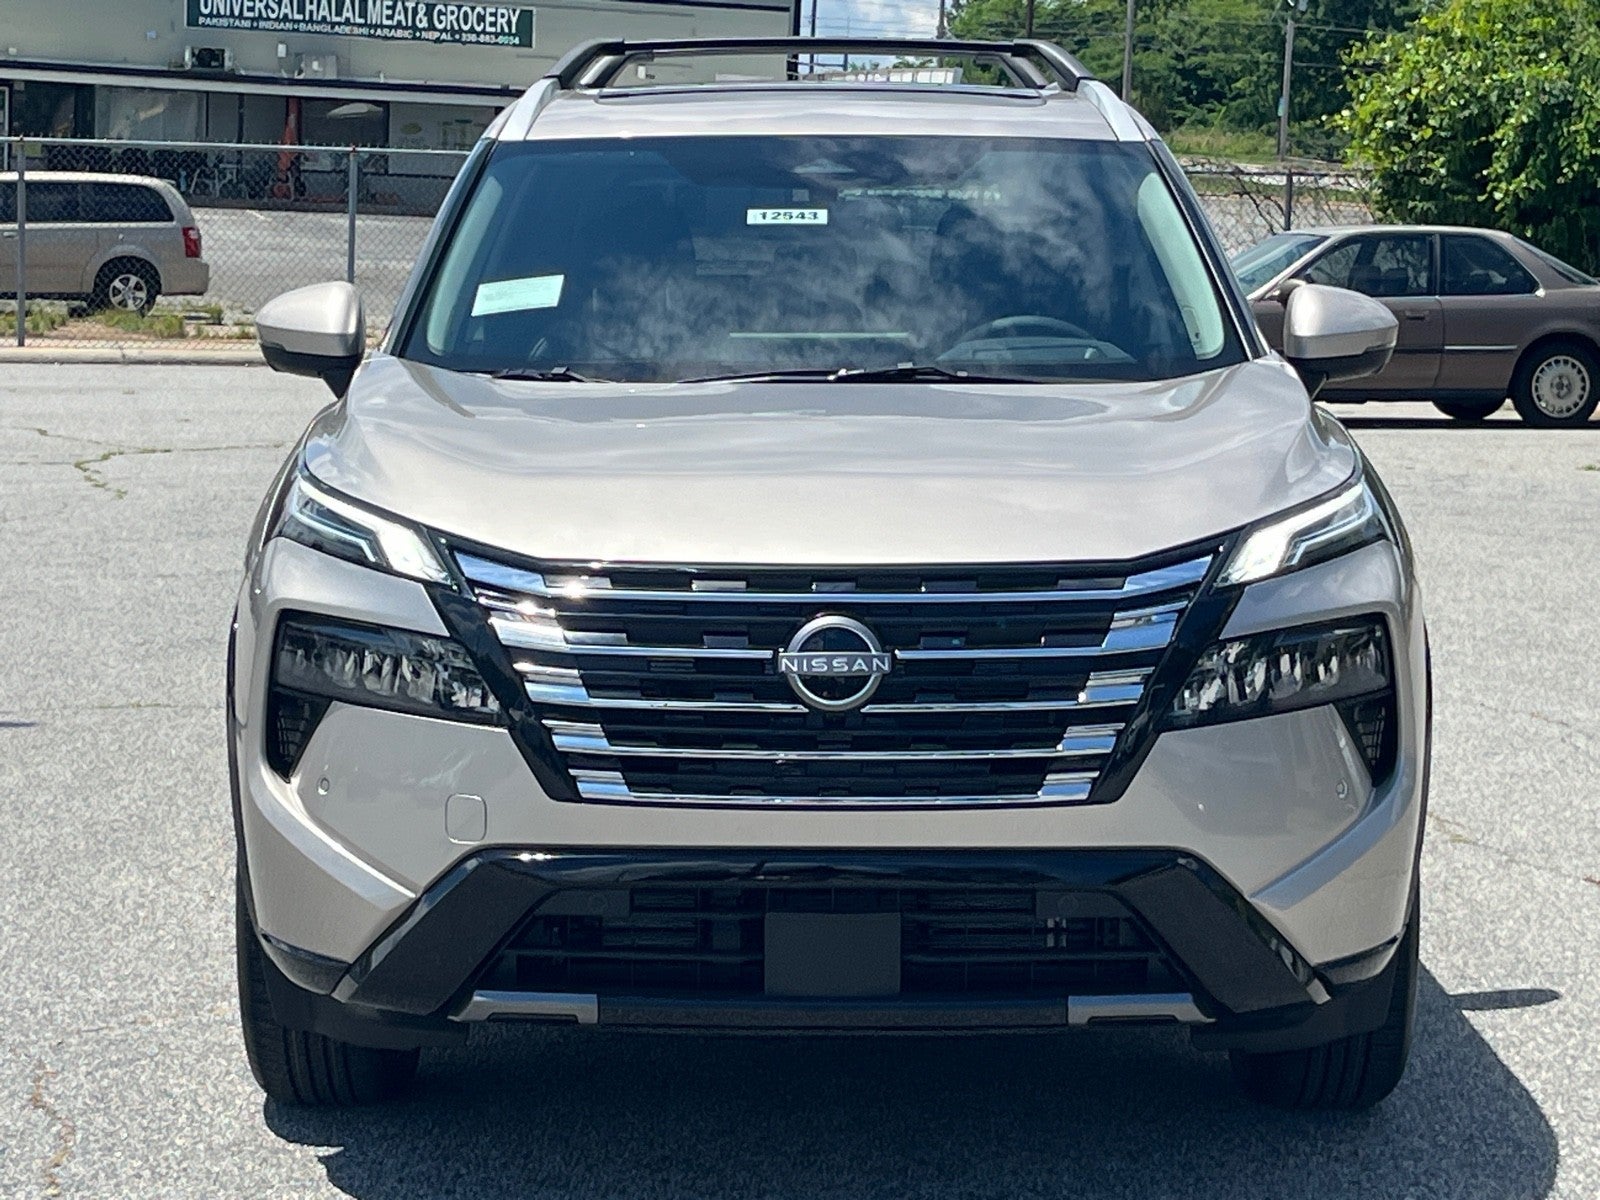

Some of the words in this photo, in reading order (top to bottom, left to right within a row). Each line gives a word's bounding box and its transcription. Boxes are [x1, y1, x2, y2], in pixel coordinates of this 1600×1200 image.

[200, 0, 303, 20] UNIVERSAL
[305, 0, 367, 24] HALAL
[367, 0, 415, 27] MEAT
[415, 3, 428, 28] &
[433, 4, 520, 34] GROCERY
[258, 21, 293, 31] INDIAN
[375, 27, 414, 39] ARABIC
[420, 31, 454, 41] NEPAL
[760, 211, 819, 220] 12543
[781, 657, 889, 672] NISSAN
